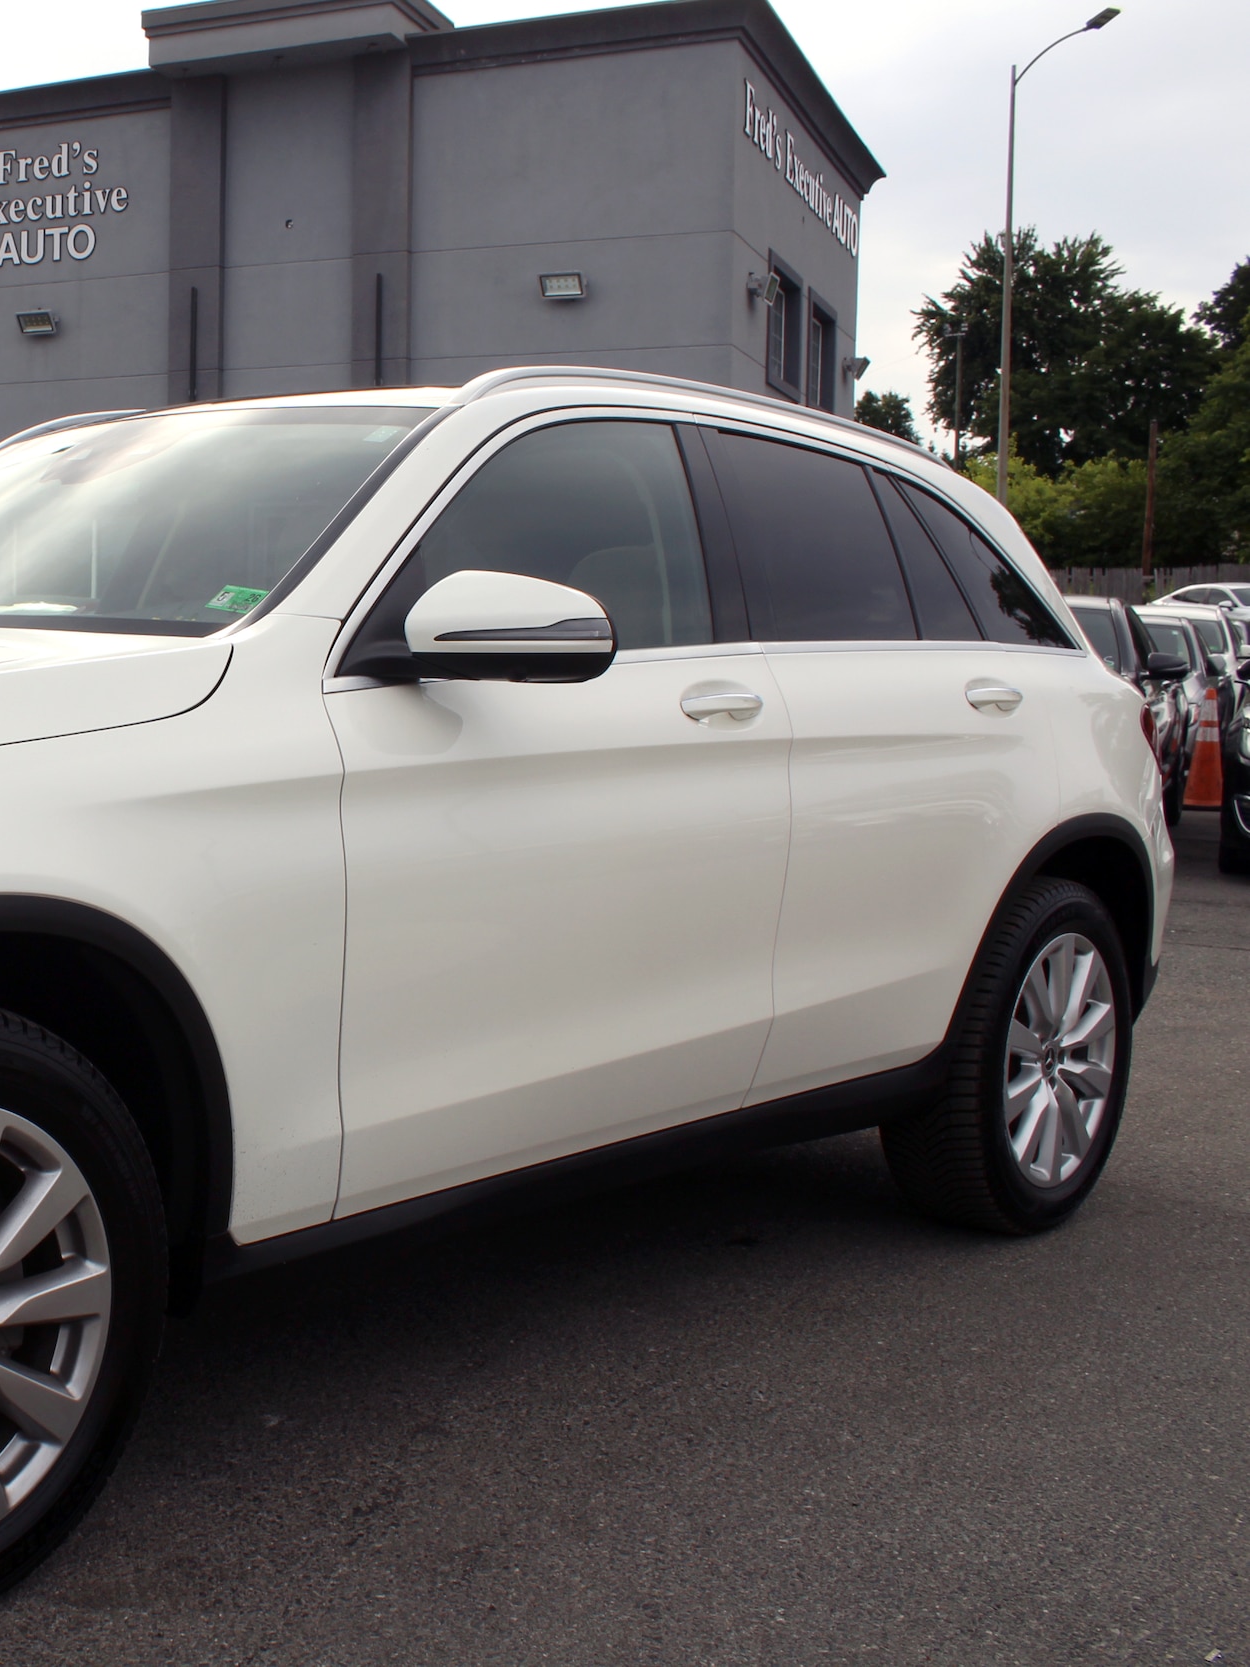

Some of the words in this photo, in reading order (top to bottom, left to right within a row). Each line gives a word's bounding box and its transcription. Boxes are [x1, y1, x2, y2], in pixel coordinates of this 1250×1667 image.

[744, 78, 782, 171] Fred's
[785, 130, 832, 228] Executive
[832, 193, 859, 257] AUTO
